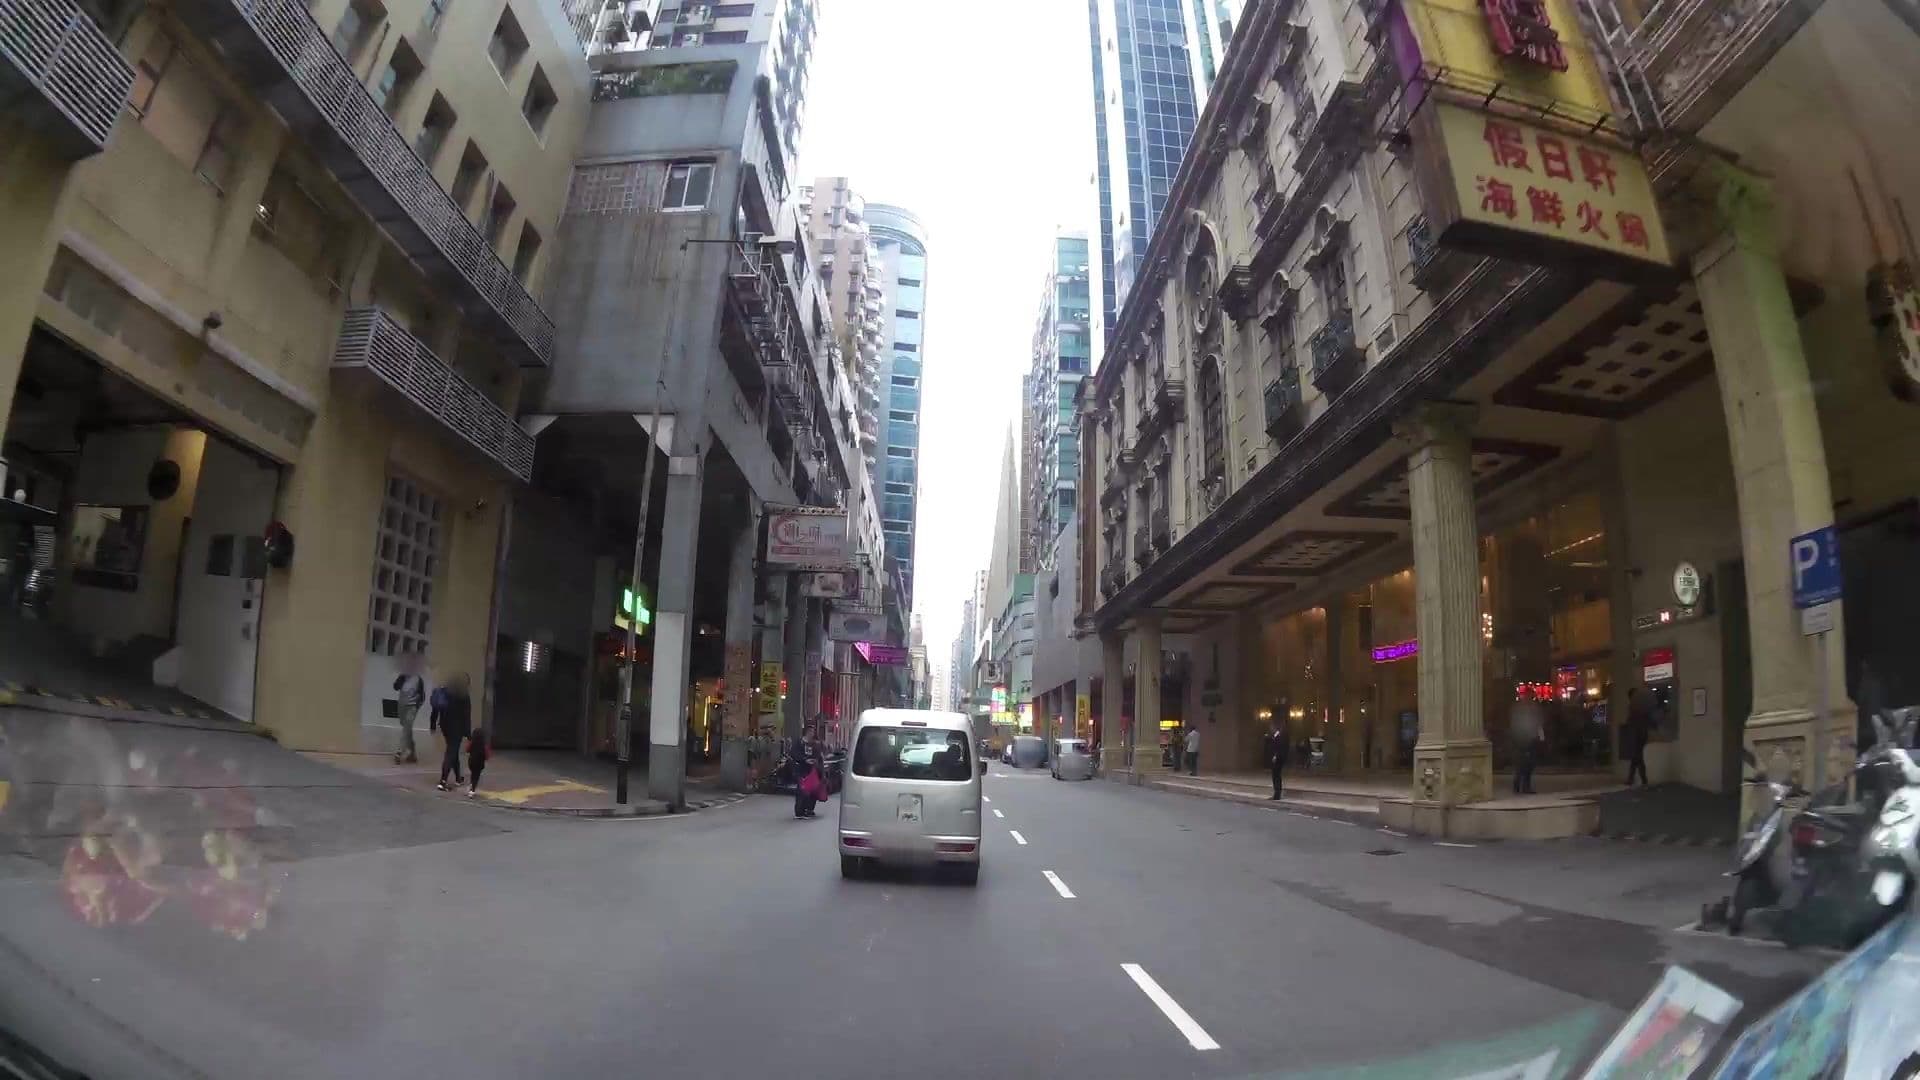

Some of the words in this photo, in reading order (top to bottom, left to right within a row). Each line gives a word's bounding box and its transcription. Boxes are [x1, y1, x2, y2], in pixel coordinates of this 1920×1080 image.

[1483, 119, 1616, 197] 假日軒
[1476, 175, 1650, 251] 海鮮火鍋
[1793, 539, 1819, 590] P
